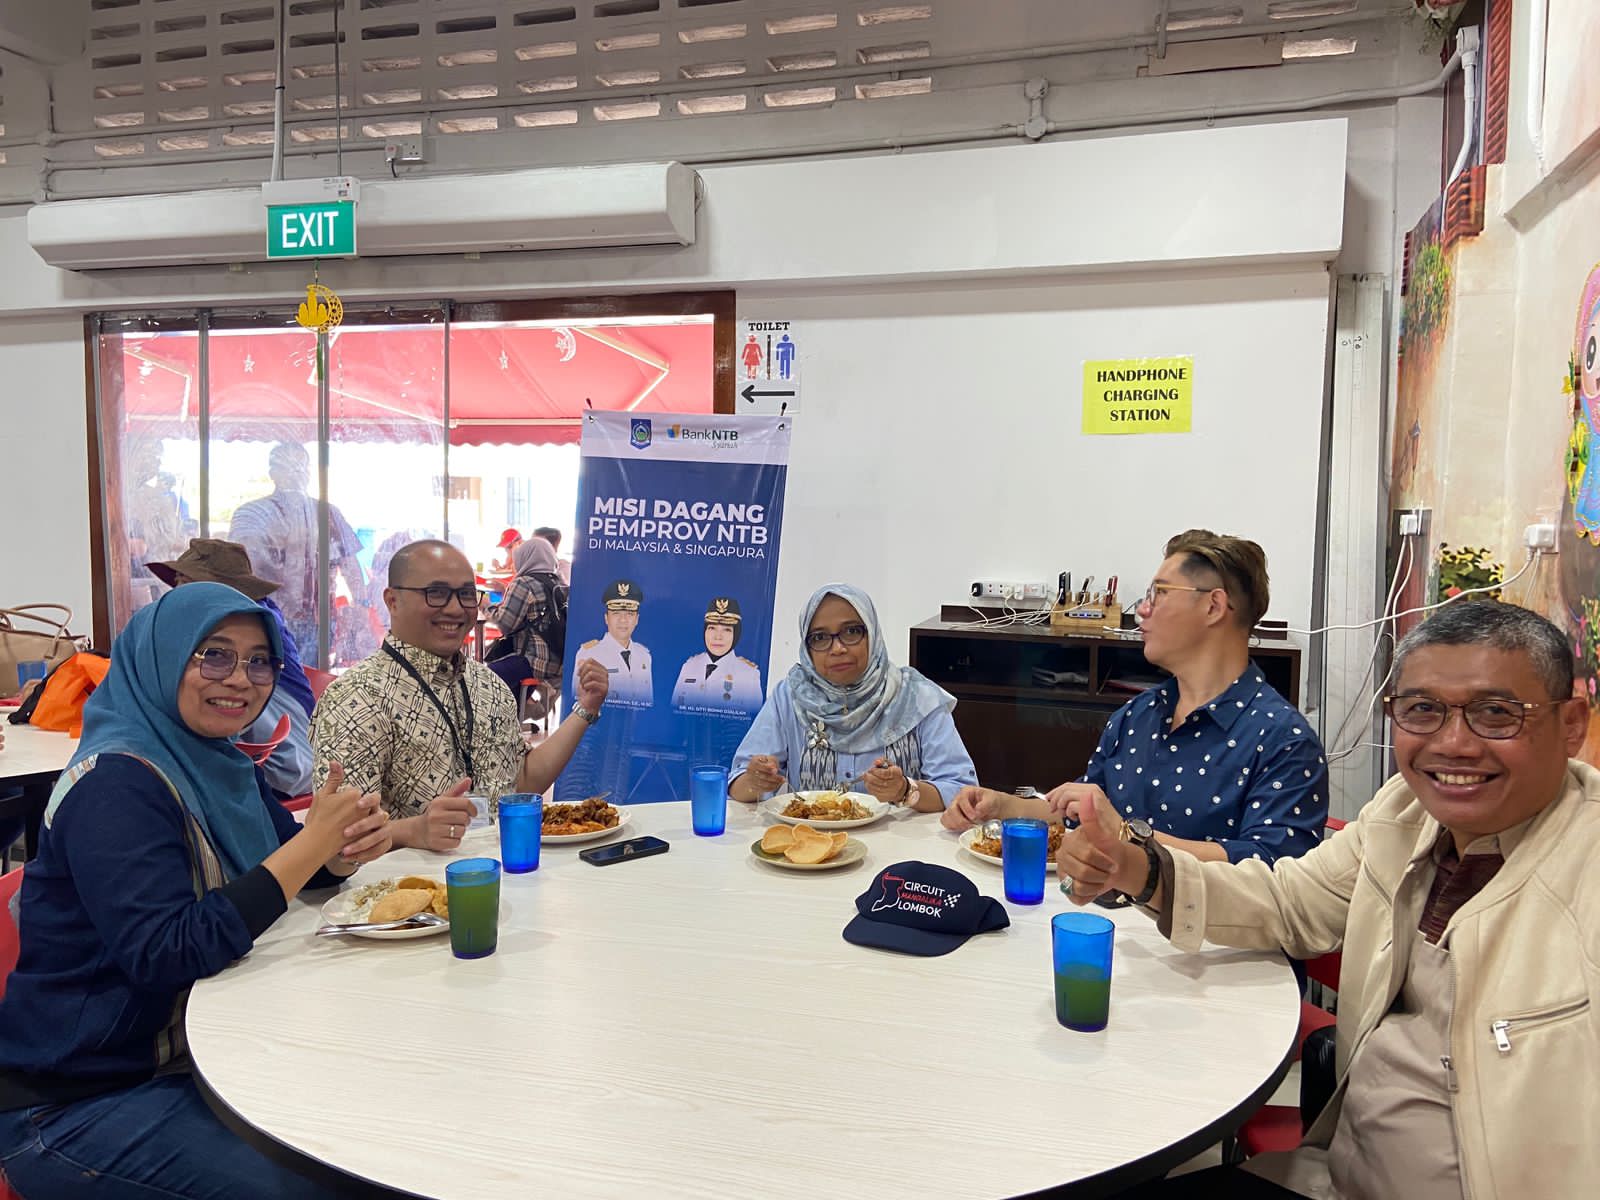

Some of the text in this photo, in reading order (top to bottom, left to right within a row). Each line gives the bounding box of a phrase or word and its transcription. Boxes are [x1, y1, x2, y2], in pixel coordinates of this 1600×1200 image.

[282, 211, 339, 249] EXIT
[748, 322, 790, 331] TOILET
[1097, 368, 1188, 382] HANDPHONE
[1103, 388, 1179, 402] CHARGING
[1110, 409, 1170, 421] STATION
[594, 496, 764, 523] MISI DAGANG
[588, 517, 768, 545] PEMPROV NTB
[589, 538, 765, 559] DI MALAYSIA & SINGAPURA
[904, 881, 946, 897] CIRCUIT
[898, 901, 942, 918] LOMBOK
